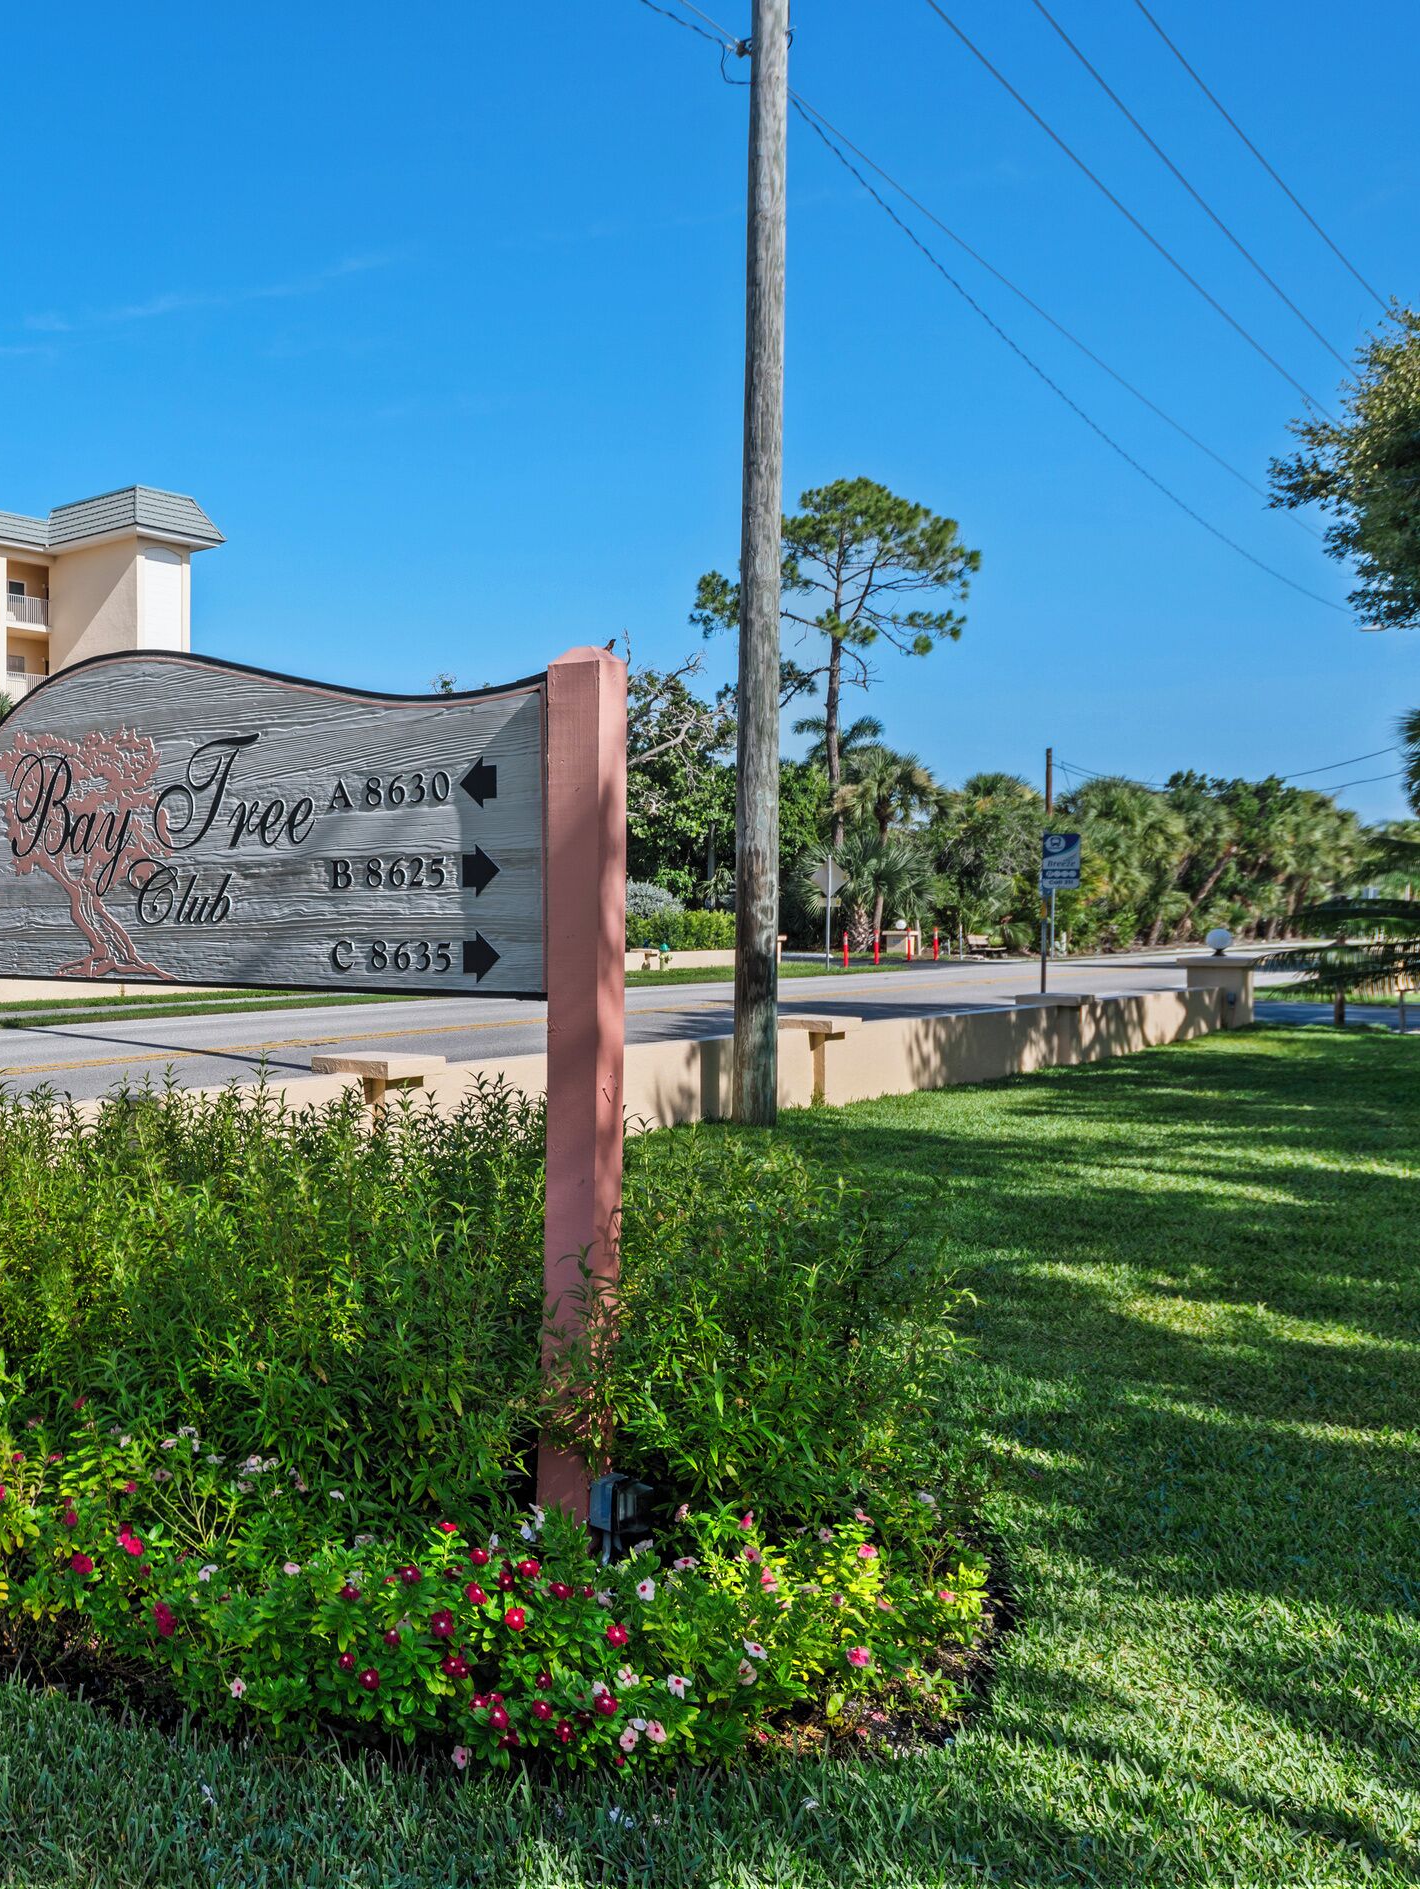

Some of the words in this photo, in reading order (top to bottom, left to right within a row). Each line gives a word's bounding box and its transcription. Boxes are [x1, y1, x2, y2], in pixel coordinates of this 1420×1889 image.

[329, 778, 353, 809] A
[365, 770, 451, 807] 8630
[10, 753, 132, 897] Bay
[154, 733, 315, 850] Tree
[128, 858, 232, 926] Club
[331, 858, 353, 890] B
[365, 856, 447, 888] 8625
[331, 940, 355, 971] C
[370, 940, 453, 972] 8635
